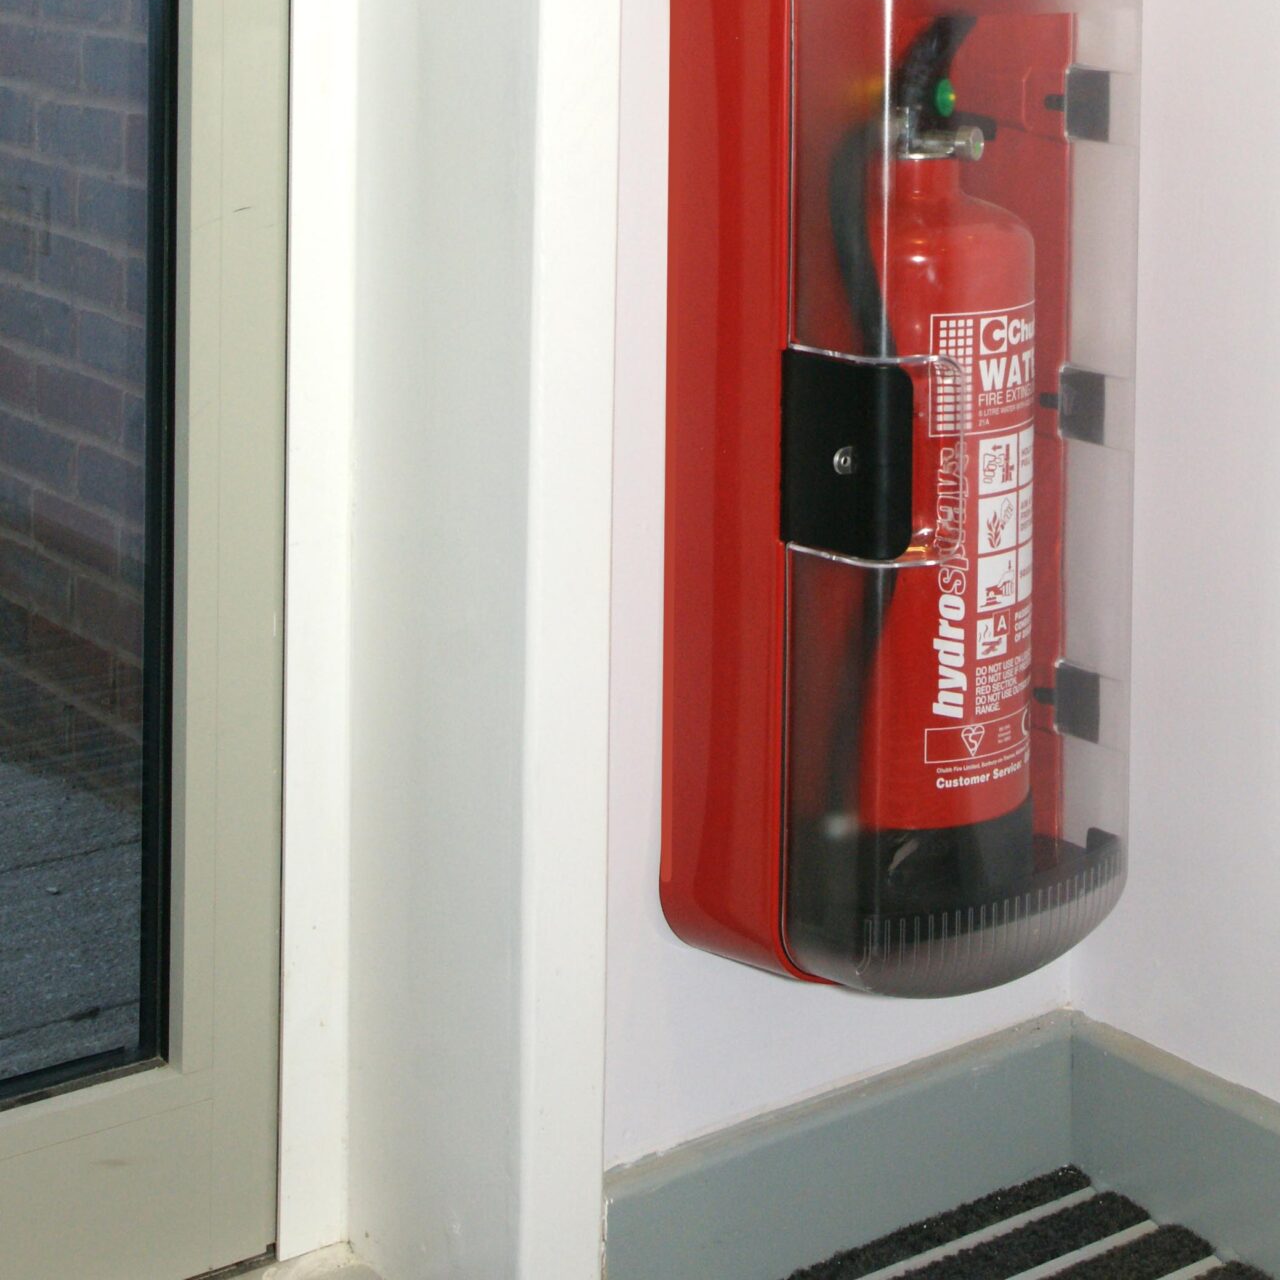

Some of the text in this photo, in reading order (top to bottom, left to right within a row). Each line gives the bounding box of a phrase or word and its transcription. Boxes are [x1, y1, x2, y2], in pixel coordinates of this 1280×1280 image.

[1008, 317, 1035, 346] Chu
[978, 348, 1035, 392] WAT
[978, 391, 1004, 407] FIRE
[997, 615, 1008, 632] A
[976, 665, 987, 677] DO
[988, 661, 1002, 674] NOT
[976, 675, 987, 687] DO
[988, 672, 1002, 684] NOT
[976, 684, 991, 696] RED
[976, 695, 987, 706] DO
[987, 691, 1001, 704] NOT
[936, 773, 990, 789] Customer
